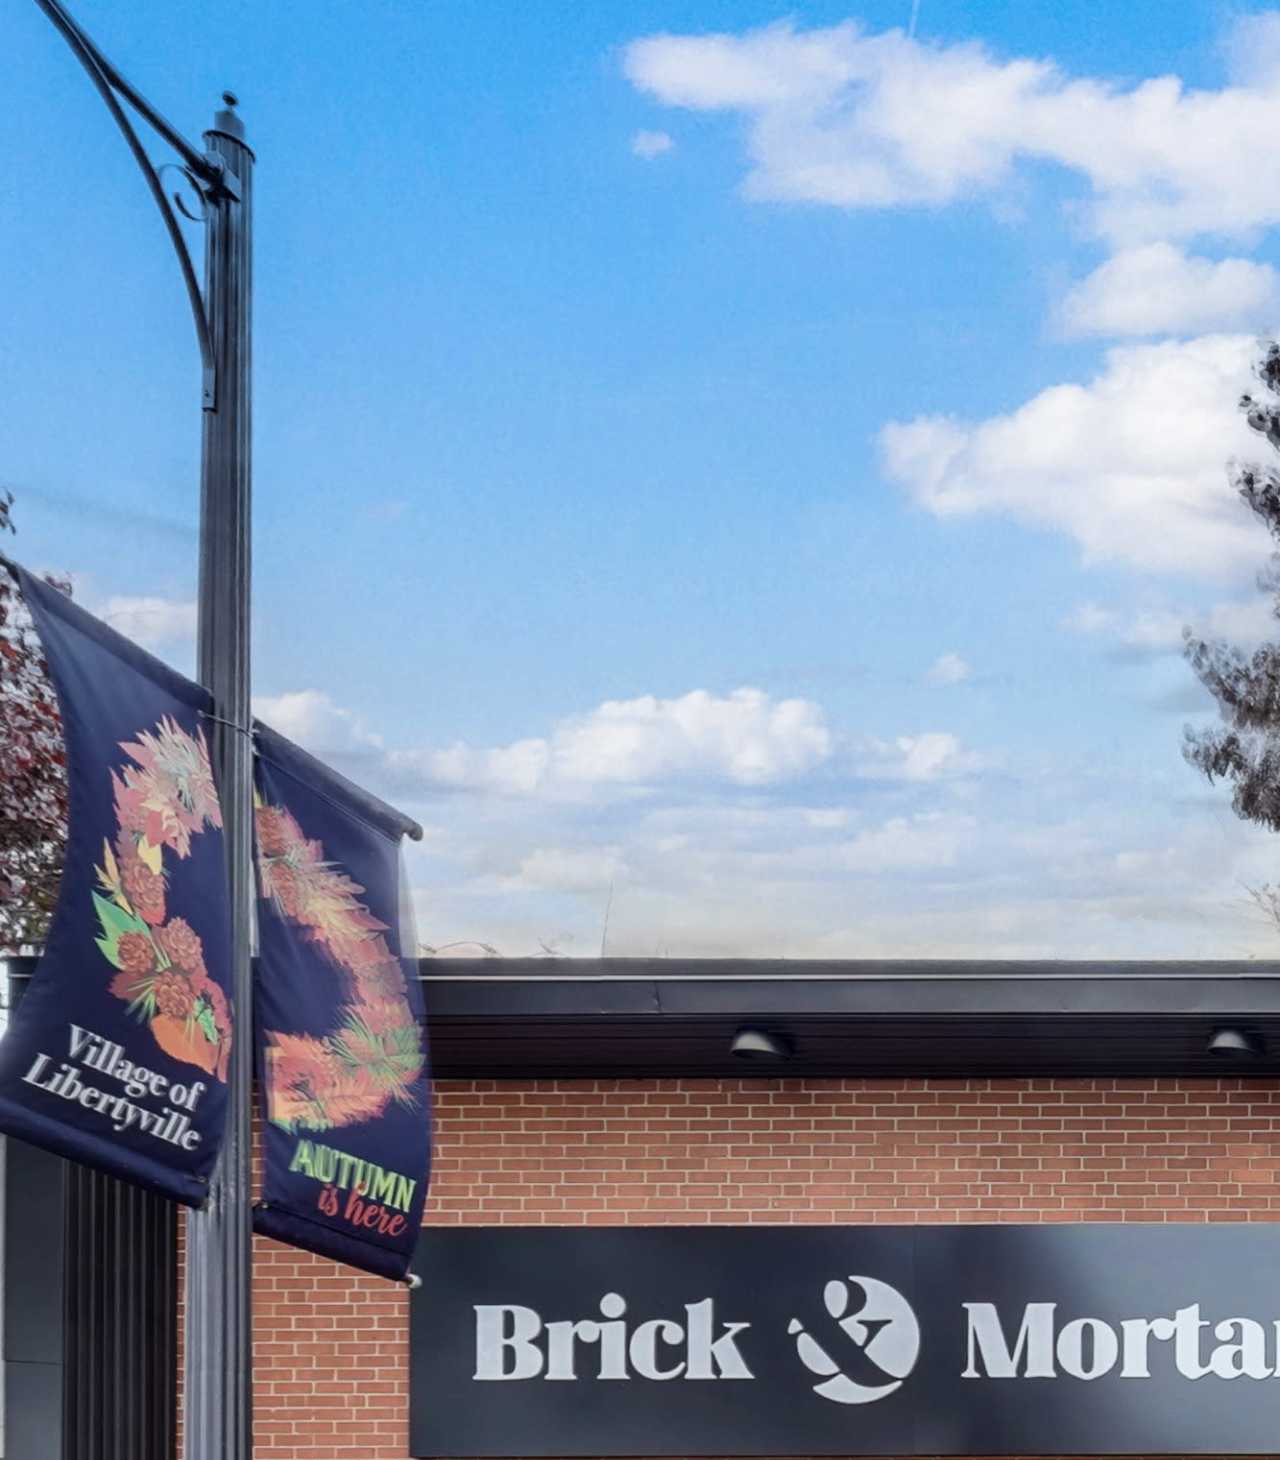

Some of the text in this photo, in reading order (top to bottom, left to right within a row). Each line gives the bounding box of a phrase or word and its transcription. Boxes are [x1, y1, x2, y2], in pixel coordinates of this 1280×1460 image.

[20, 1052, 202, 1151] Libertyville
[68, 1022, 206, 1112] Village of
[288, 1138, 417, 1214] AUTUMN
[318, 1181, 408, 1237] is here
[472, 1292, 754, 1381] Brick
[787, 1274, 921, 1404] &
